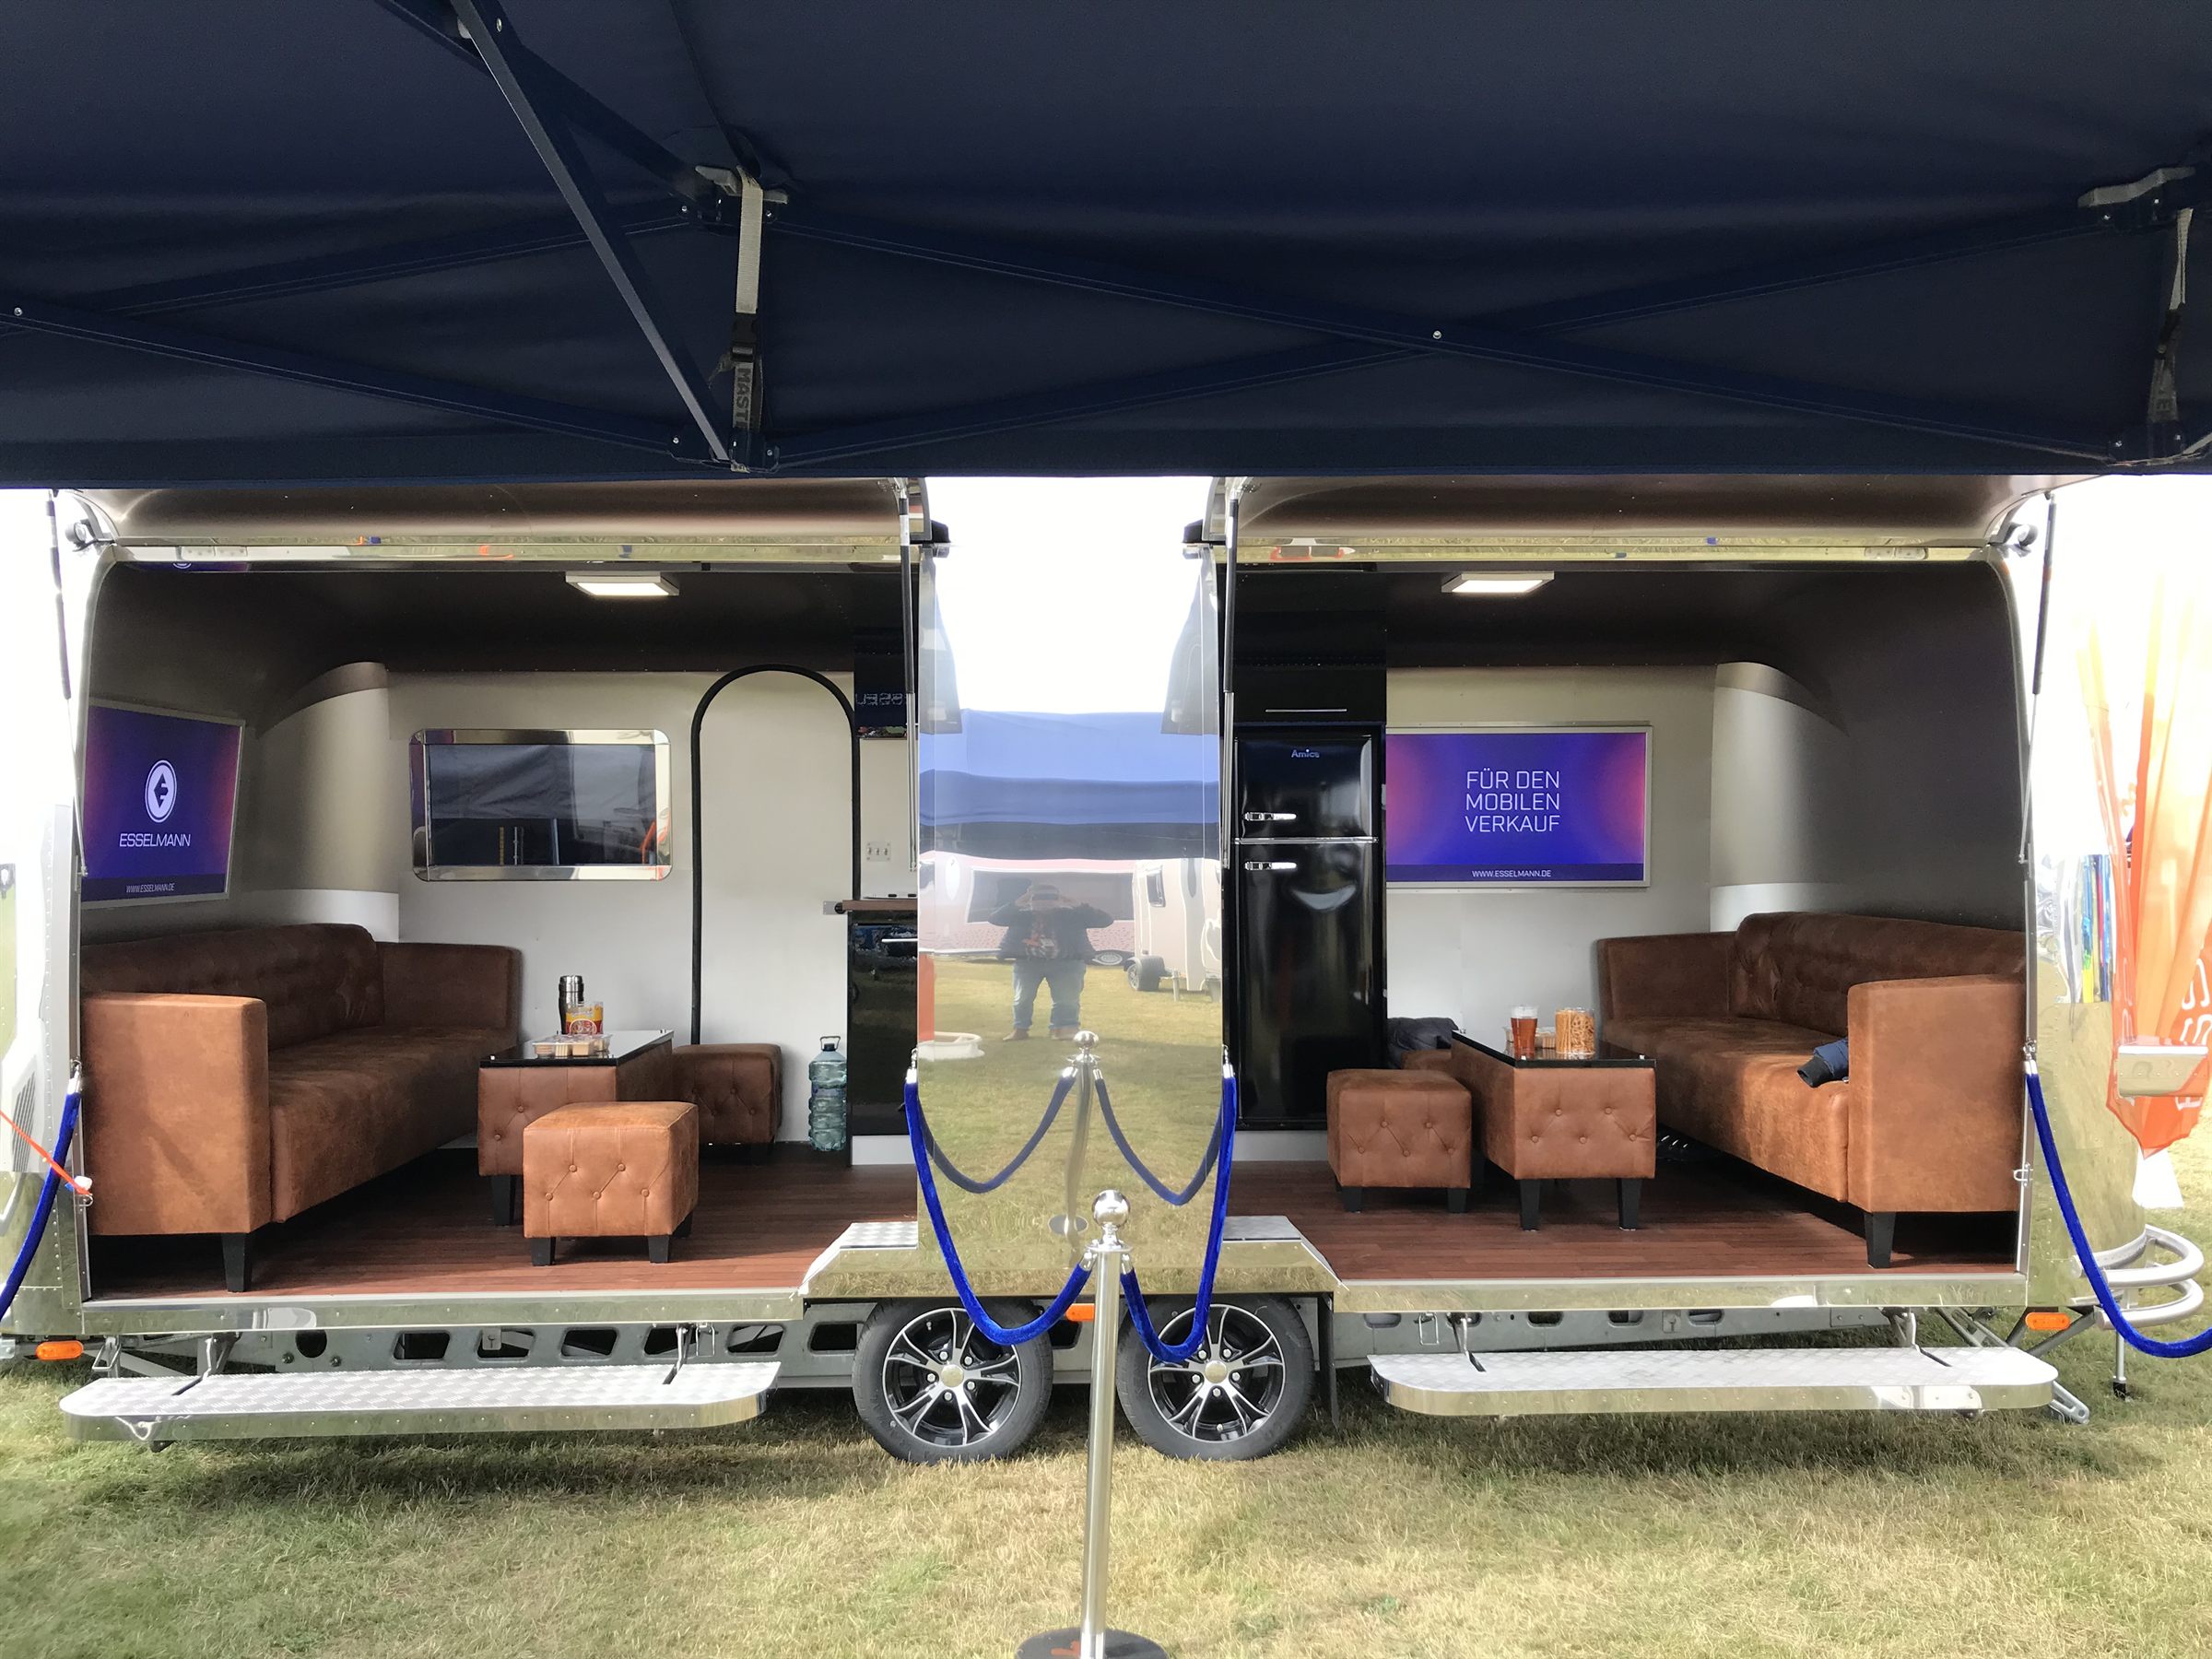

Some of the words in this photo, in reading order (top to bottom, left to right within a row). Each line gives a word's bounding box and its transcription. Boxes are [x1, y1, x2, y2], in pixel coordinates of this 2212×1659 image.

[1466, 768, 1509, 789] FÜR
[1516, 771, 1559, 789] DEN
[1466, 793, 1559, 810] MOBILEN
[1465, 815, 1560, 832] VERKAUF
[119, 832, 191, 847] ESSELMANN
[1472, 869, 1551, 877] WWW.ESSELMANN.DE
